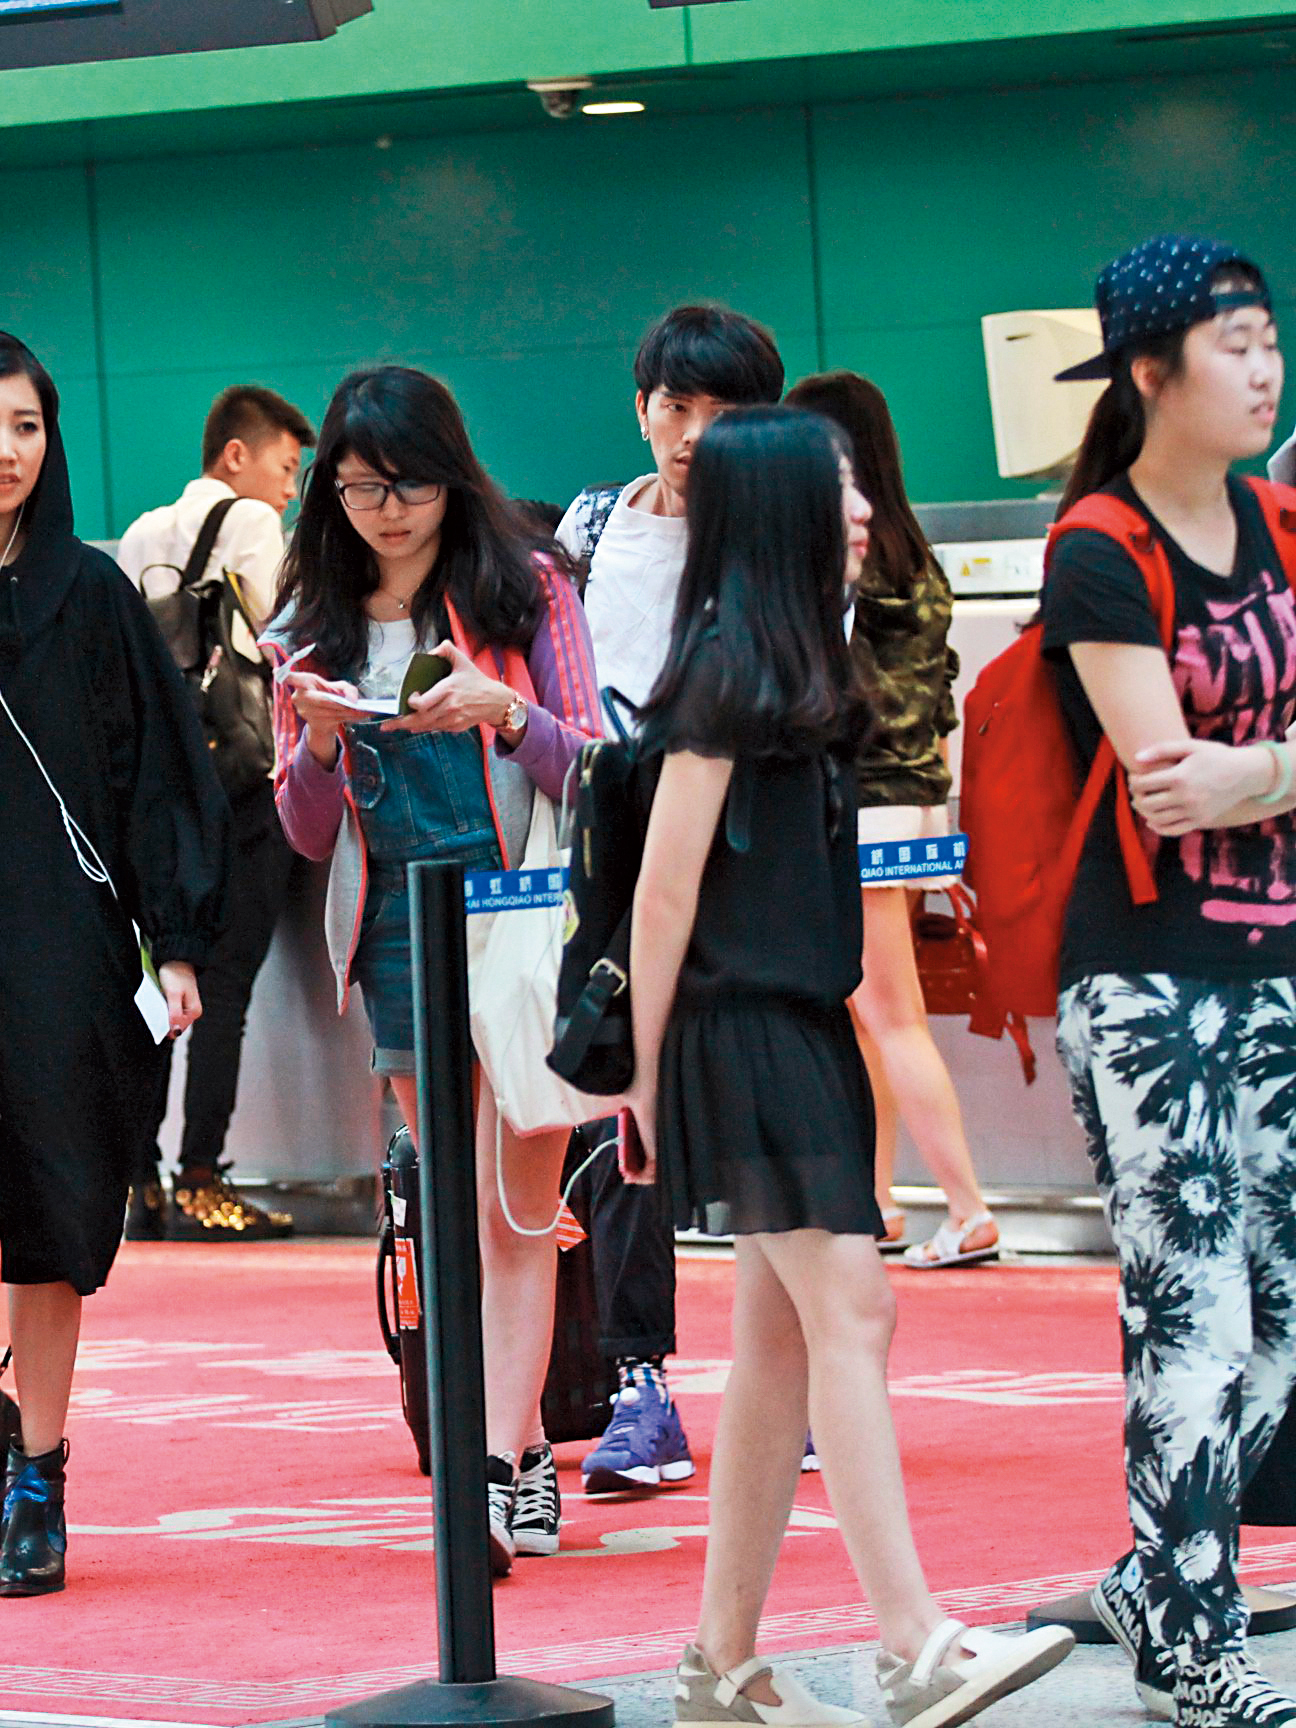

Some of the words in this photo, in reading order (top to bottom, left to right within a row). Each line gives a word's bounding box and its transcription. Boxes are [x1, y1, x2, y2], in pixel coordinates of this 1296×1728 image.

[885, 860, 953, 876] INTERNATIONAL
[482, 894, 532, 908] HONGQIAO
[1179, 1706, 1230, 1728] SHOE
